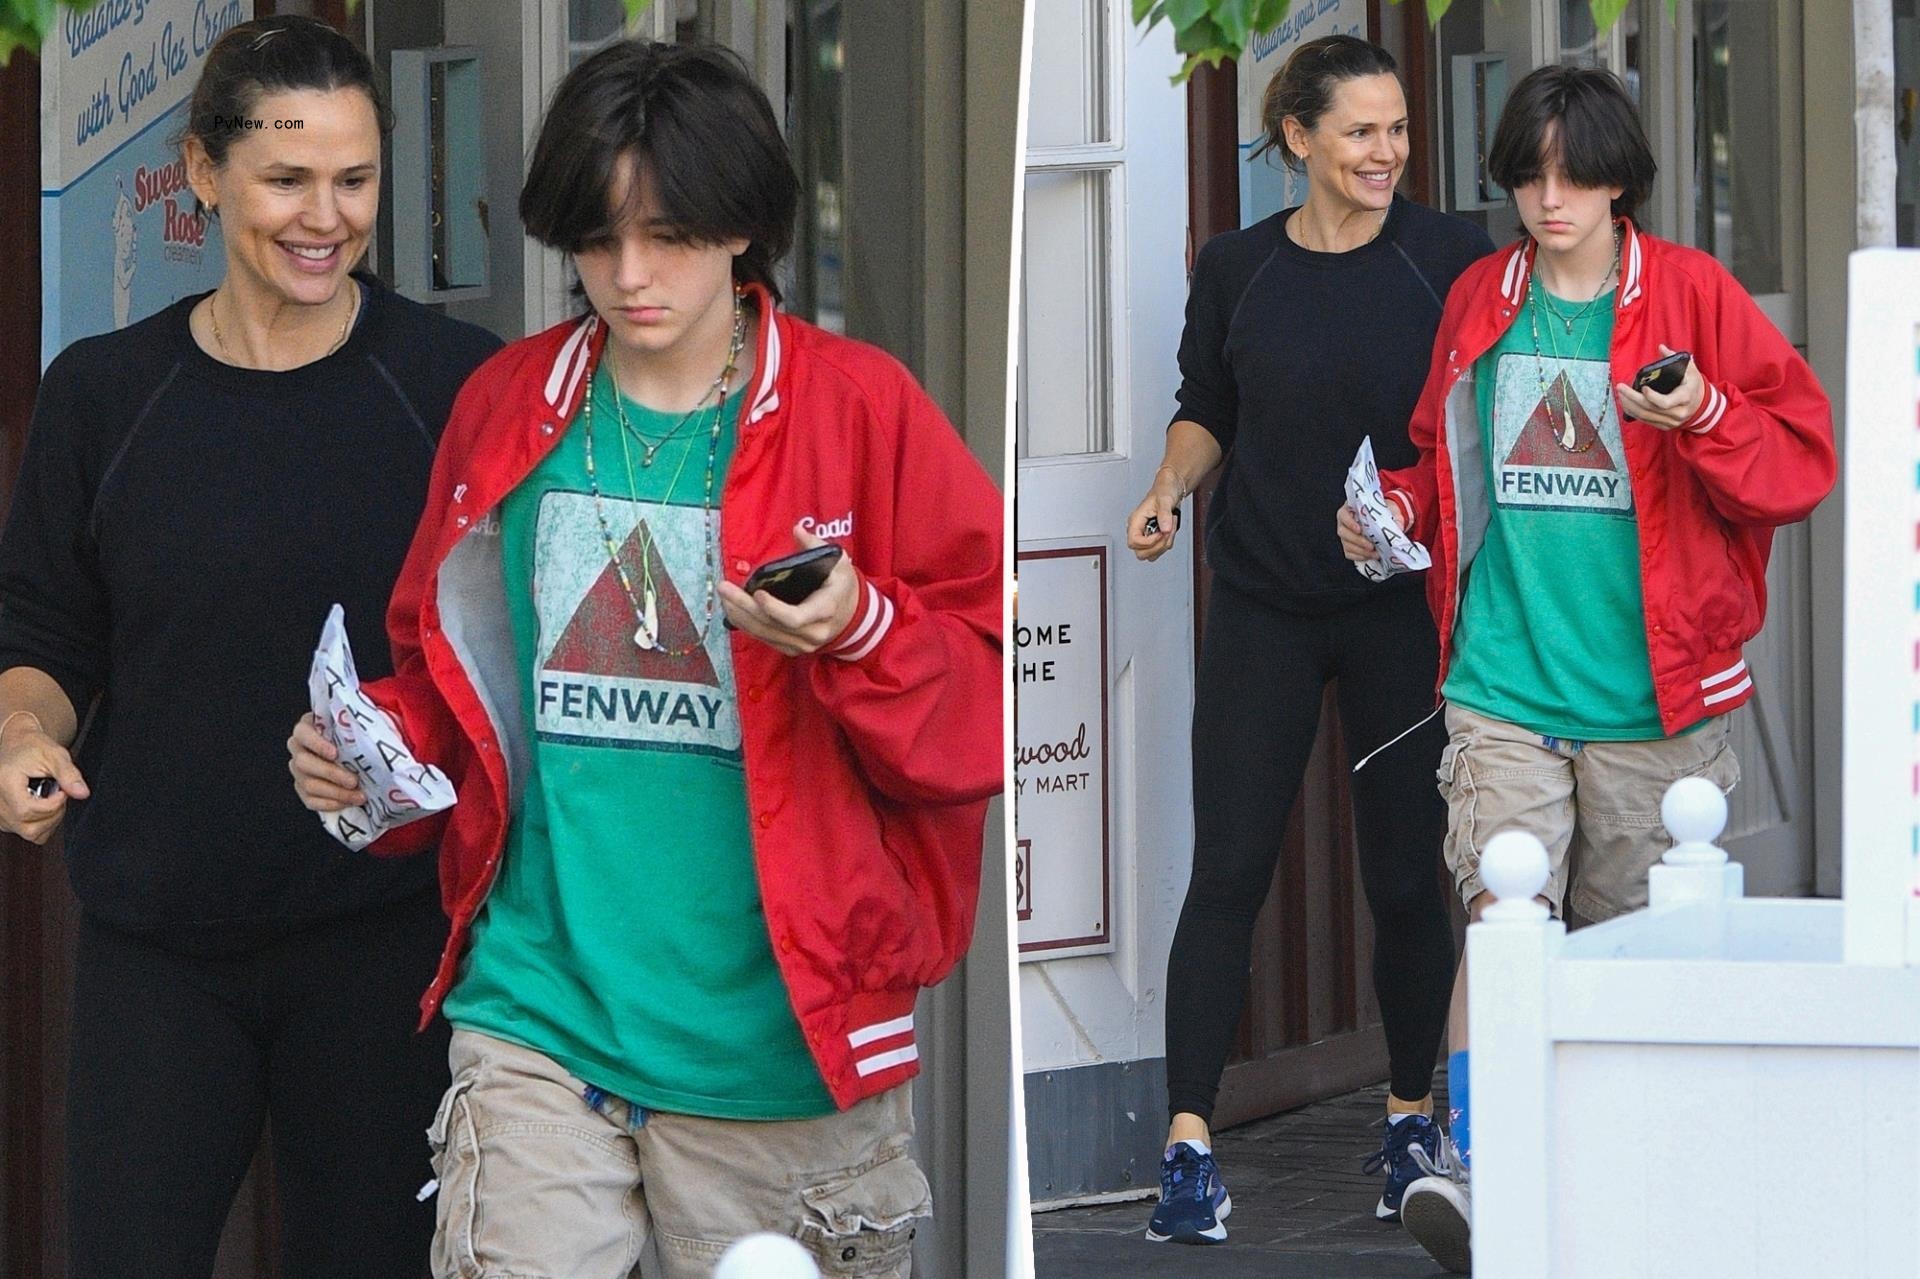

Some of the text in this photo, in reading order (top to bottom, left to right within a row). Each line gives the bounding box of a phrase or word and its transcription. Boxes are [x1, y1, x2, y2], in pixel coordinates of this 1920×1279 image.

[77, 77, 114, 146] with
[118, 41, 158, 124] Good
[161, 21, 188, 80] Ice
[164, 198, 205, 248] Rose
[1501, 470, 1620, 499] FENWAY
[539, 680, 723, 730] FENWAY
[1036, 772, 1090, 795] MART
